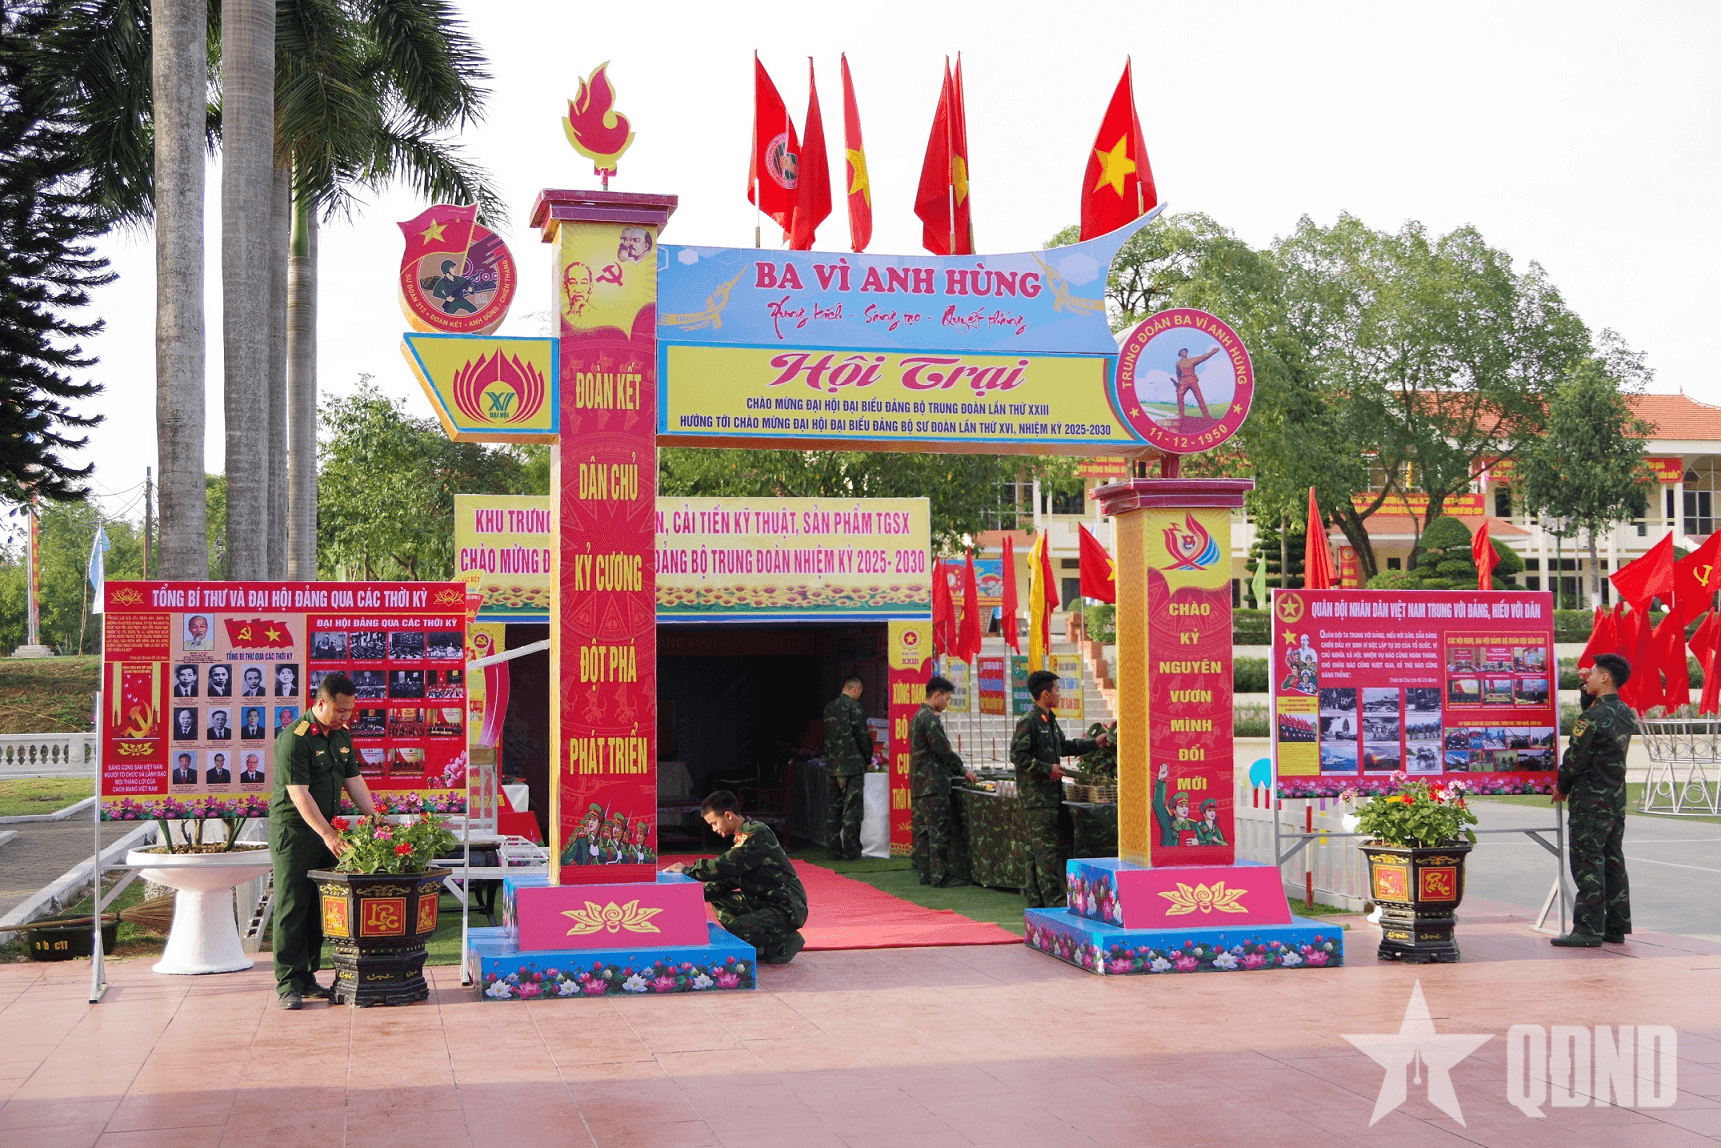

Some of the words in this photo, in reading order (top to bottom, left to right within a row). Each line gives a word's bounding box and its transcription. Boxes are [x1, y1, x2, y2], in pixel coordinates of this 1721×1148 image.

[755, 261, 804, 290] BA
[812, 257, 851, 291] VÌ
[860, 266, 935, 294] ANH
[945, 263, 1042, 298] HÙNG
[415, 301, 427, 313] 312
[1122, 344, 1140, 389] TRUNG
[1137, 316, 1171, 344] ĐOÀN
[1174, 314, 1192, 325] BA
[1195, 317, 1208, 329] VÌ
[1207, 324, 1233, 347] ANH
[1229, 346, 1248, 386] HÙNG
[575, 364, 614, 410] ĐOÀN
[616, 361, 642, 410] KẾT
[768, 353, 887, 393] Hội
[899, 356, 1030, 397] Trại
[746, 396, 772, 409] CHÀO
[775, 396, 803, 410] MỪNG
[806, 399, 822, 413] ĐẠI
[825, 398, 840, 413] HỘI
[843, 400, 859, 415] ĐẠI
[862, 397, 883, 412] BIỂU
[885, 398, 911, 414] ĐẢNG
[913, 399, 926, 416] BỘ
[929, 401, 958, 414] TRUNG
[961, 400, 986, 415] ĐOÀN
[988, 399, 1006, 415] LẦN
[1008, 401, 1026, 415] THỨ
[1028, 404, 1049, 416] XXIII
[680, 414, 713, 428] HƯỚNG
[716, 414, 731, 428] TỚI
[733, 414, 759, 428] CHÀO
[762, 415, 791, 429] MỪNG
[793, 418, 809, 432] ĐẠI
[812, 416, 828, 433] HỘI
[830, 419, 846, 434] ĐẠI
[849, 415, 870, 432] BIỂU
[872, 417, 898, 432] ĐẢNG
[901, 418, 913, 435] BỘ
[916, 420, 930, 432] SƯ
[931, 418, 957, 433] ĐOÀN
[959, 418, 977, 434] LẦN
[979, 420, 997, 434] THỨ
[999, 422, 1017, 435] XVI,
[1019, 420, 1048, 437] NHIỆM
[1050, 421, 1062, 435] KỲ
[1064, 423, 1111, 436] 2025-2030
[579, 455, 608, 500] DÂN
[610, 451, 639, 501] CHỦ
[475, 509, 505, 533] KHU
[673, 503, 696, 534] CẢI
[700, 504, 730, 534] TIẾN
[734, 507, 751, 534] KỸ
[754, 507, 799, 539] THUẬT,
[803, 503, 830, 534] SẢN
[834, 503, 873, 535] PHẨM
[876, 512, 910, 534] TGSX
[500, 543, 539, 574] MỪNG
[574, 541, 593, 592] KỶ
[595, 550, 643, 592] CƯƠNG
[691, 544, 708, 579] BỘ
[711, 549, 753, 574] TRUNG
[756, 544, 791, 574] ĐOÀN
[794, 544, 835, 579] NHIỆM
[838, 544, 855, 574] KỲ
[895, 549, 925, 574] 2030
[152, 583, 185, 607] TỔNG
[187, 586, 201, 607] BÍ
[203, 588, 228, 607] THƯ
[230, 586, 246, 607] VÀ
[248, 590, 269, 611] ĐẠI
[272, 587, 292, 611] HỘI
[294, 584, 328, 608] ĐẢNG
[331, 590, 354, 609] QUA
[357, 587, 381, 608] CÁC
[383, 586, 410, 608] THỜI
[412, 587, 428, 608] KỲ
[1168, 600, 1211, 616] CHÀO
[1311, 598, 1333, 619] QUÂN
[1334, 599, 1348, 621] ĐỘI
[1349, 599, 1371, 618] NHÂN
[1372, 599, 1389, 618] DÂN
[1390, 599, 1407, 621] VIỆT
[1408, 602, 1426, 618] NAM
[1427, 603, 1453, 618] TRUNG
[1453, 600, 1466, 618] VỚI
[1467, 598, 1491, 620] ĐẢNG,
[1492, 598, 1510, 618] HIẾU
[1511, 600, 1524, 618] VỚI
[1525, 600, 1541, 618] DÂN
[317, 619, 333, 629] ĐẠI
[335, 617, 351, 629] HỘI
[353, 617, 379, 627] ĐẢNG
[381, 619, 399, 628] QUA
[401, 617, 421, 627] CÁC
[423, 617, 443, 627] THỜI
[1180, 628, 1200, 645] KỶ
[579, 637, 607, 692] ĐỘT
[609, 637, 638, 683] PHÁ
[1159, 658, 1222, 674] NGUYÊN
[1170, 689, 1212, 703] VƯƠN
[1170, 716, 1213, 732] MÌNH
[569, 729, 605, 775] PHÁT
[607, 721, 648, 775] TRIỂN
[1178, 743, 1205, 761] ĐỔI
[1177, 774, 1208, 791] MỚI
